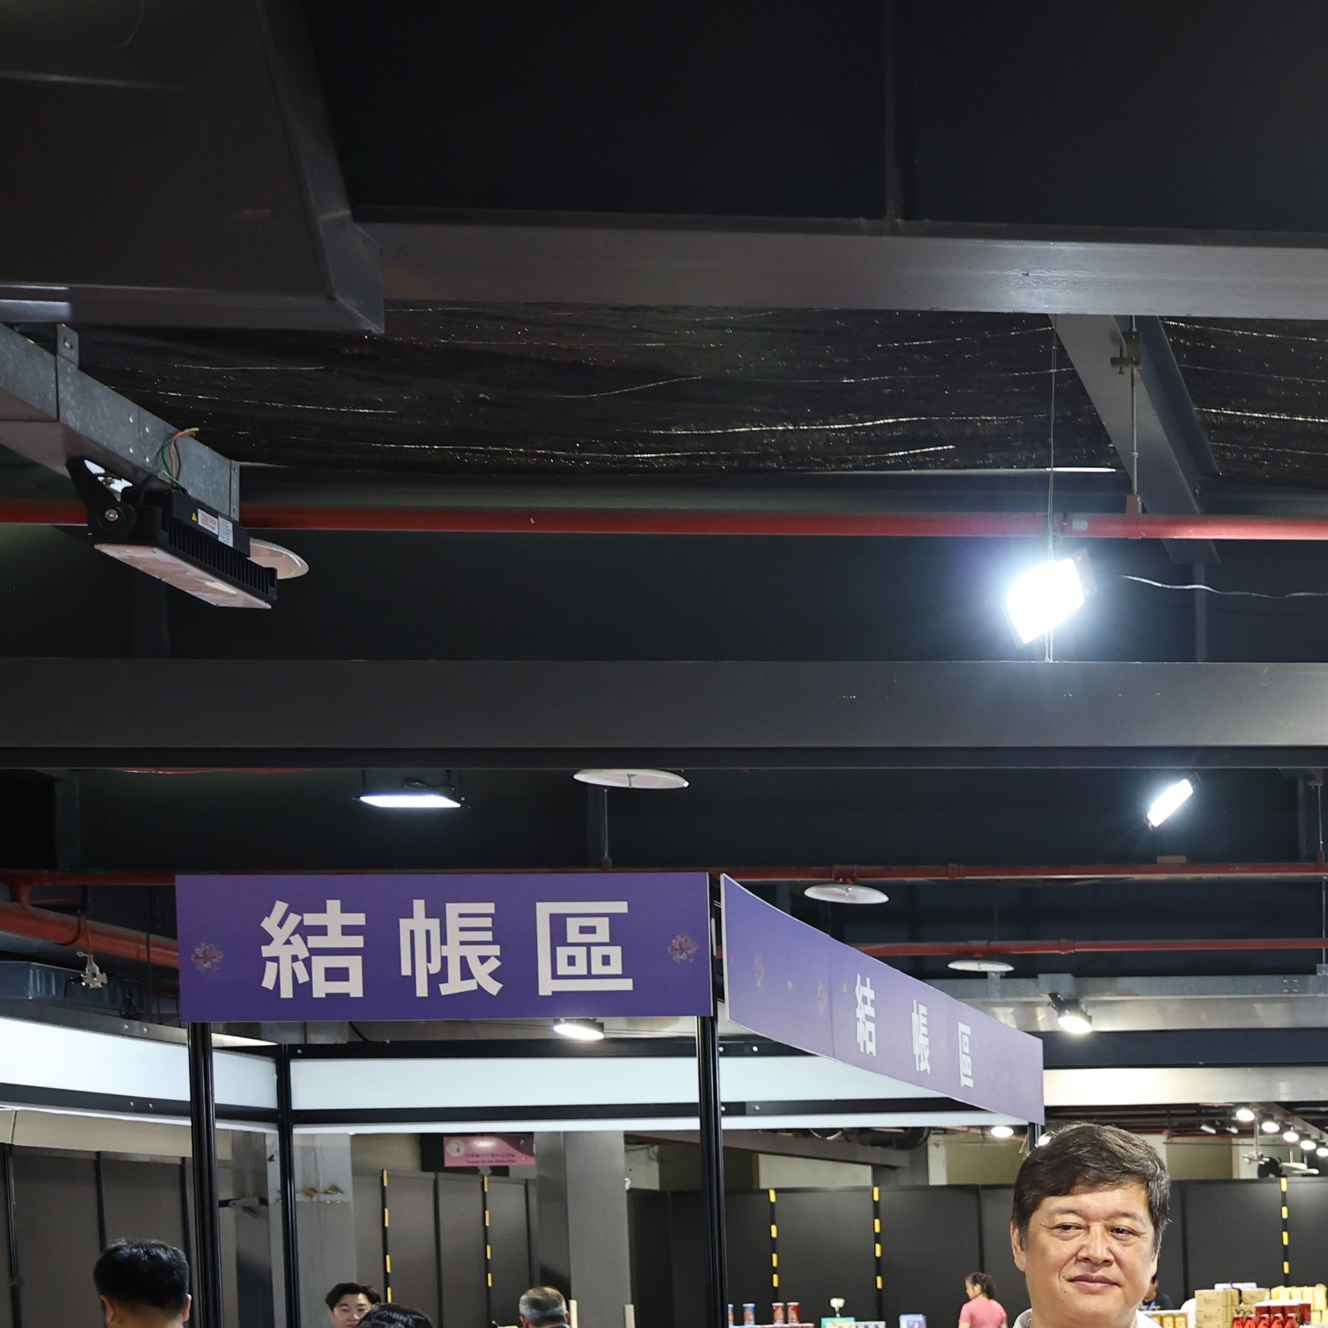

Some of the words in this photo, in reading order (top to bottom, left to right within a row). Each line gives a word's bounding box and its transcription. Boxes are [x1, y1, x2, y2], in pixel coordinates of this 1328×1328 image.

[260, 899, 634, 998] 結帳區
[855, 973, 974, 1088] 結帳區
